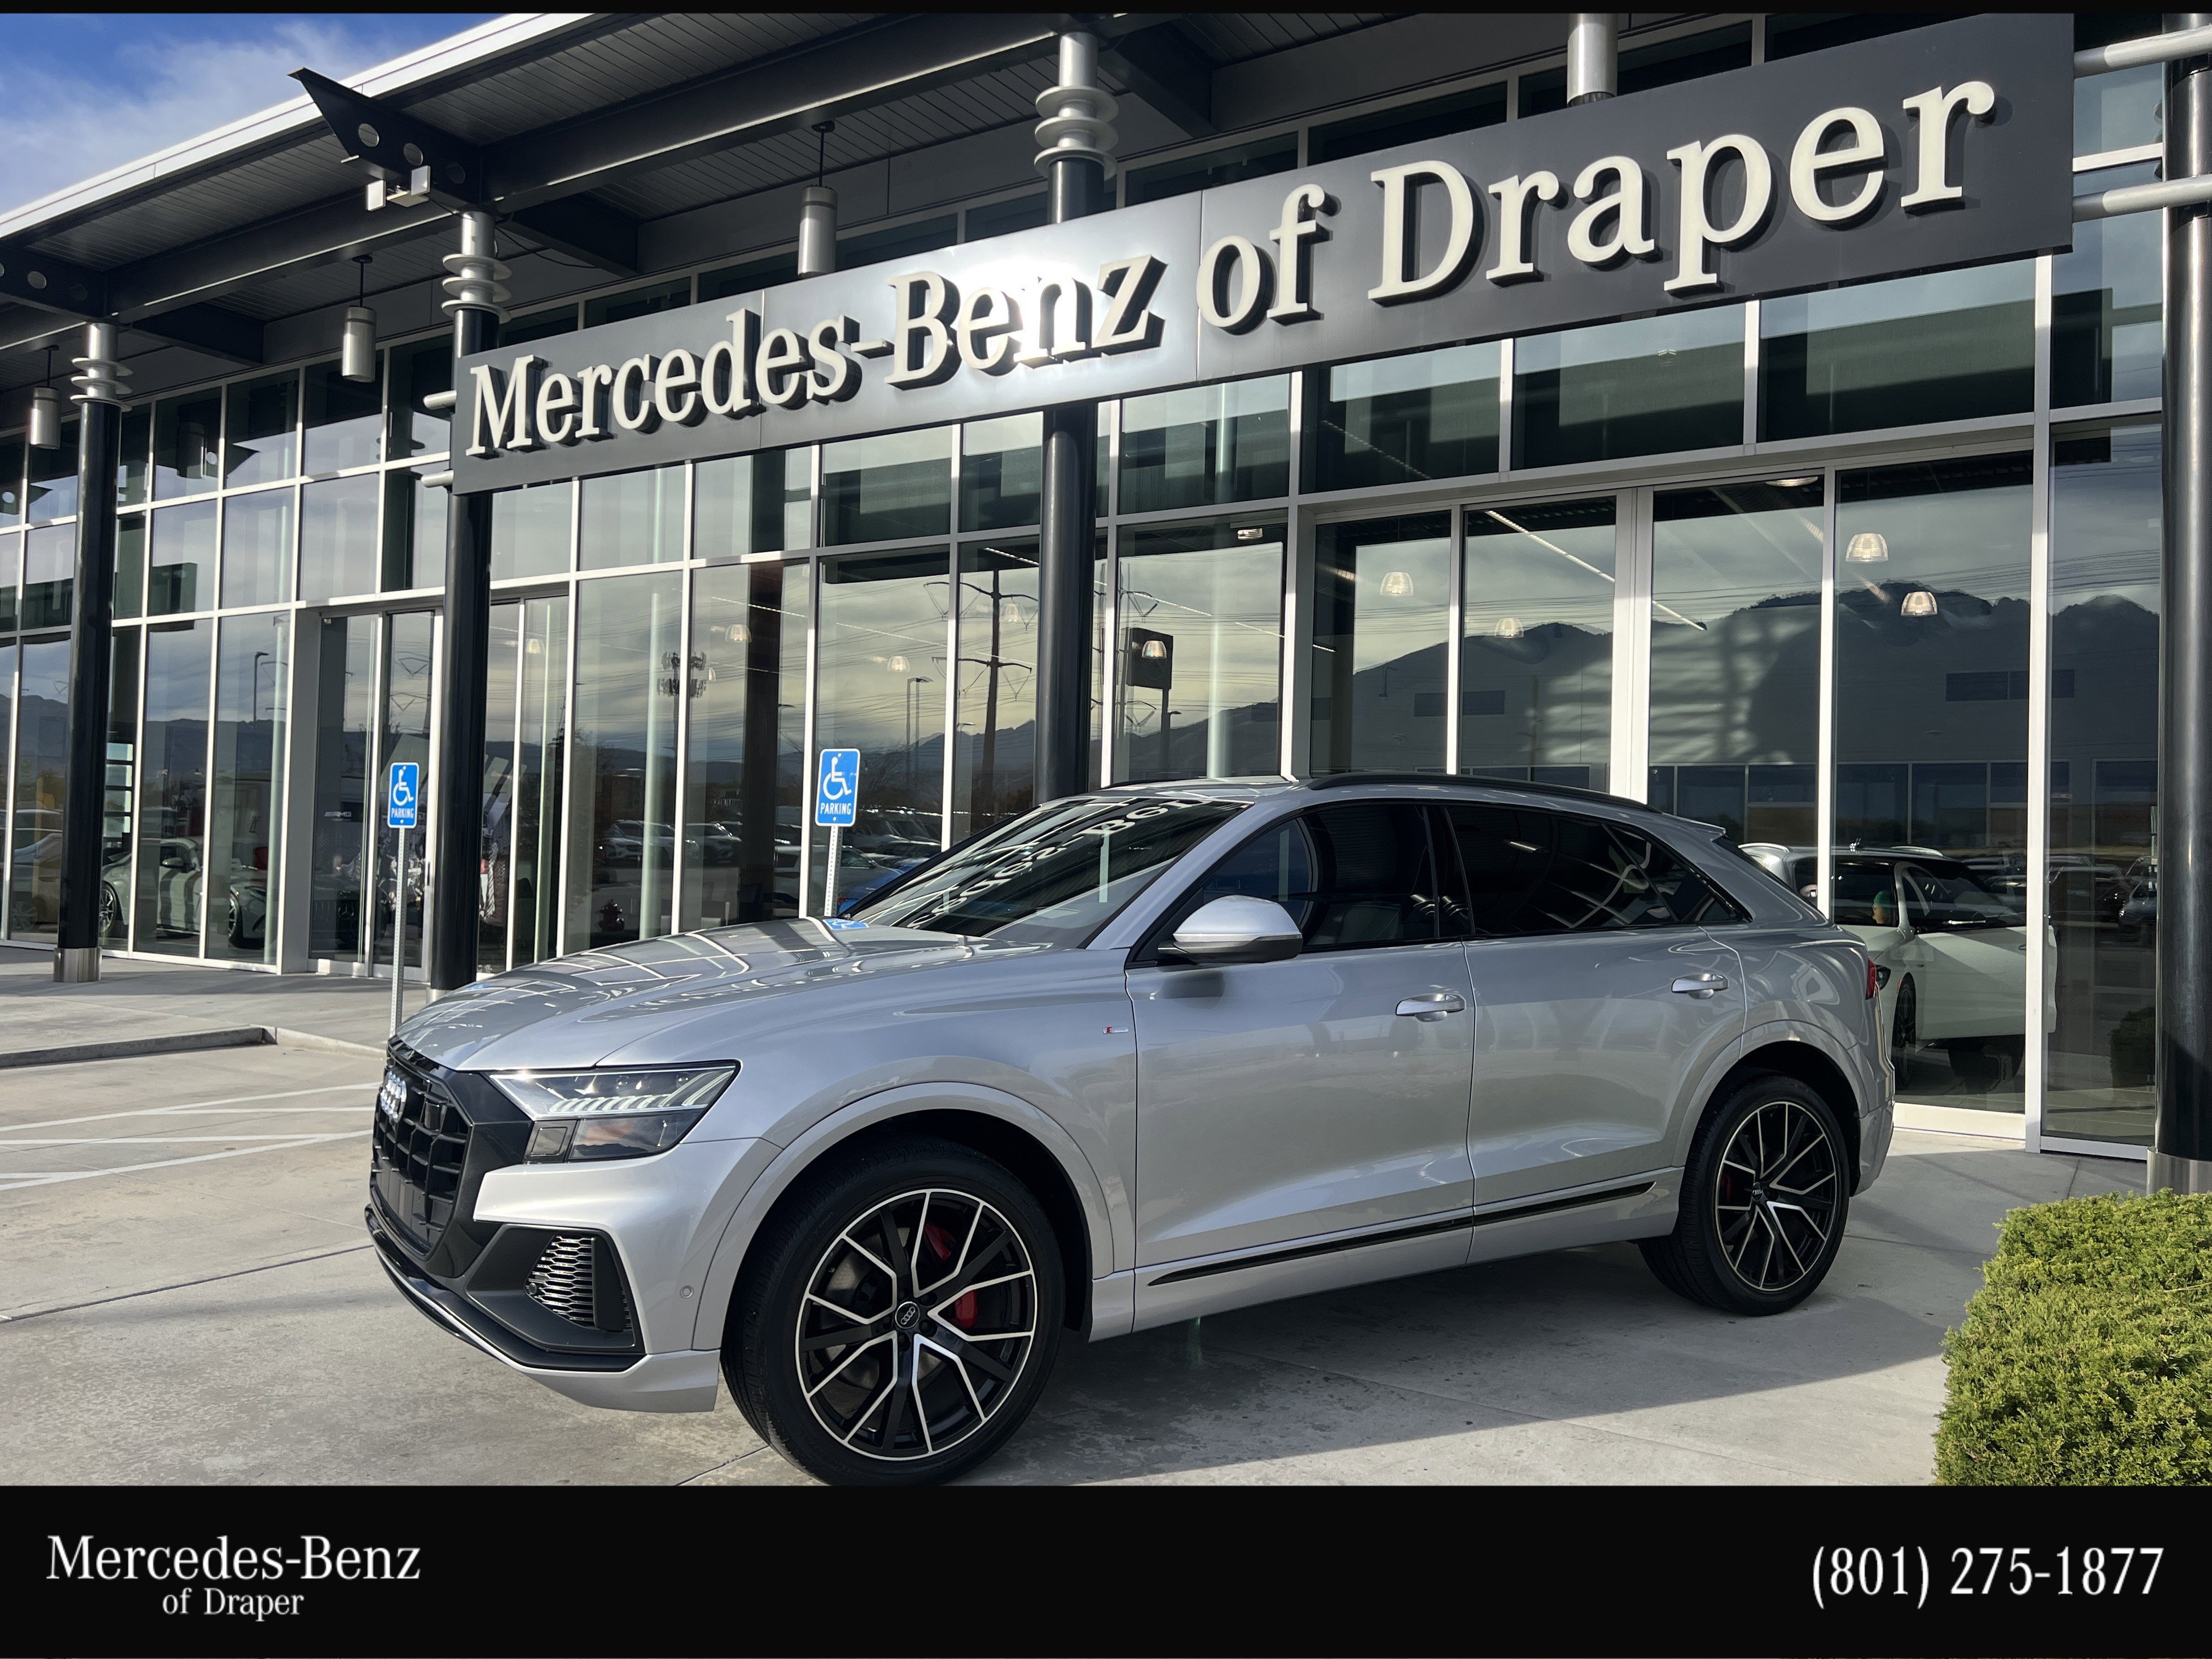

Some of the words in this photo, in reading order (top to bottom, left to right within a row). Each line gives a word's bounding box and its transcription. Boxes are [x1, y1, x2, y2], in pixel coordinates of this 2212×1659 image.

[465, 255, 1166, 460] Mercedes-Benz
[1196, 183, 1330, 329] of
[1368, 81, 1996, 294] Draper
[391, 807, 414, 819] PARKING
[820, 802, 852, 815] PARKING
